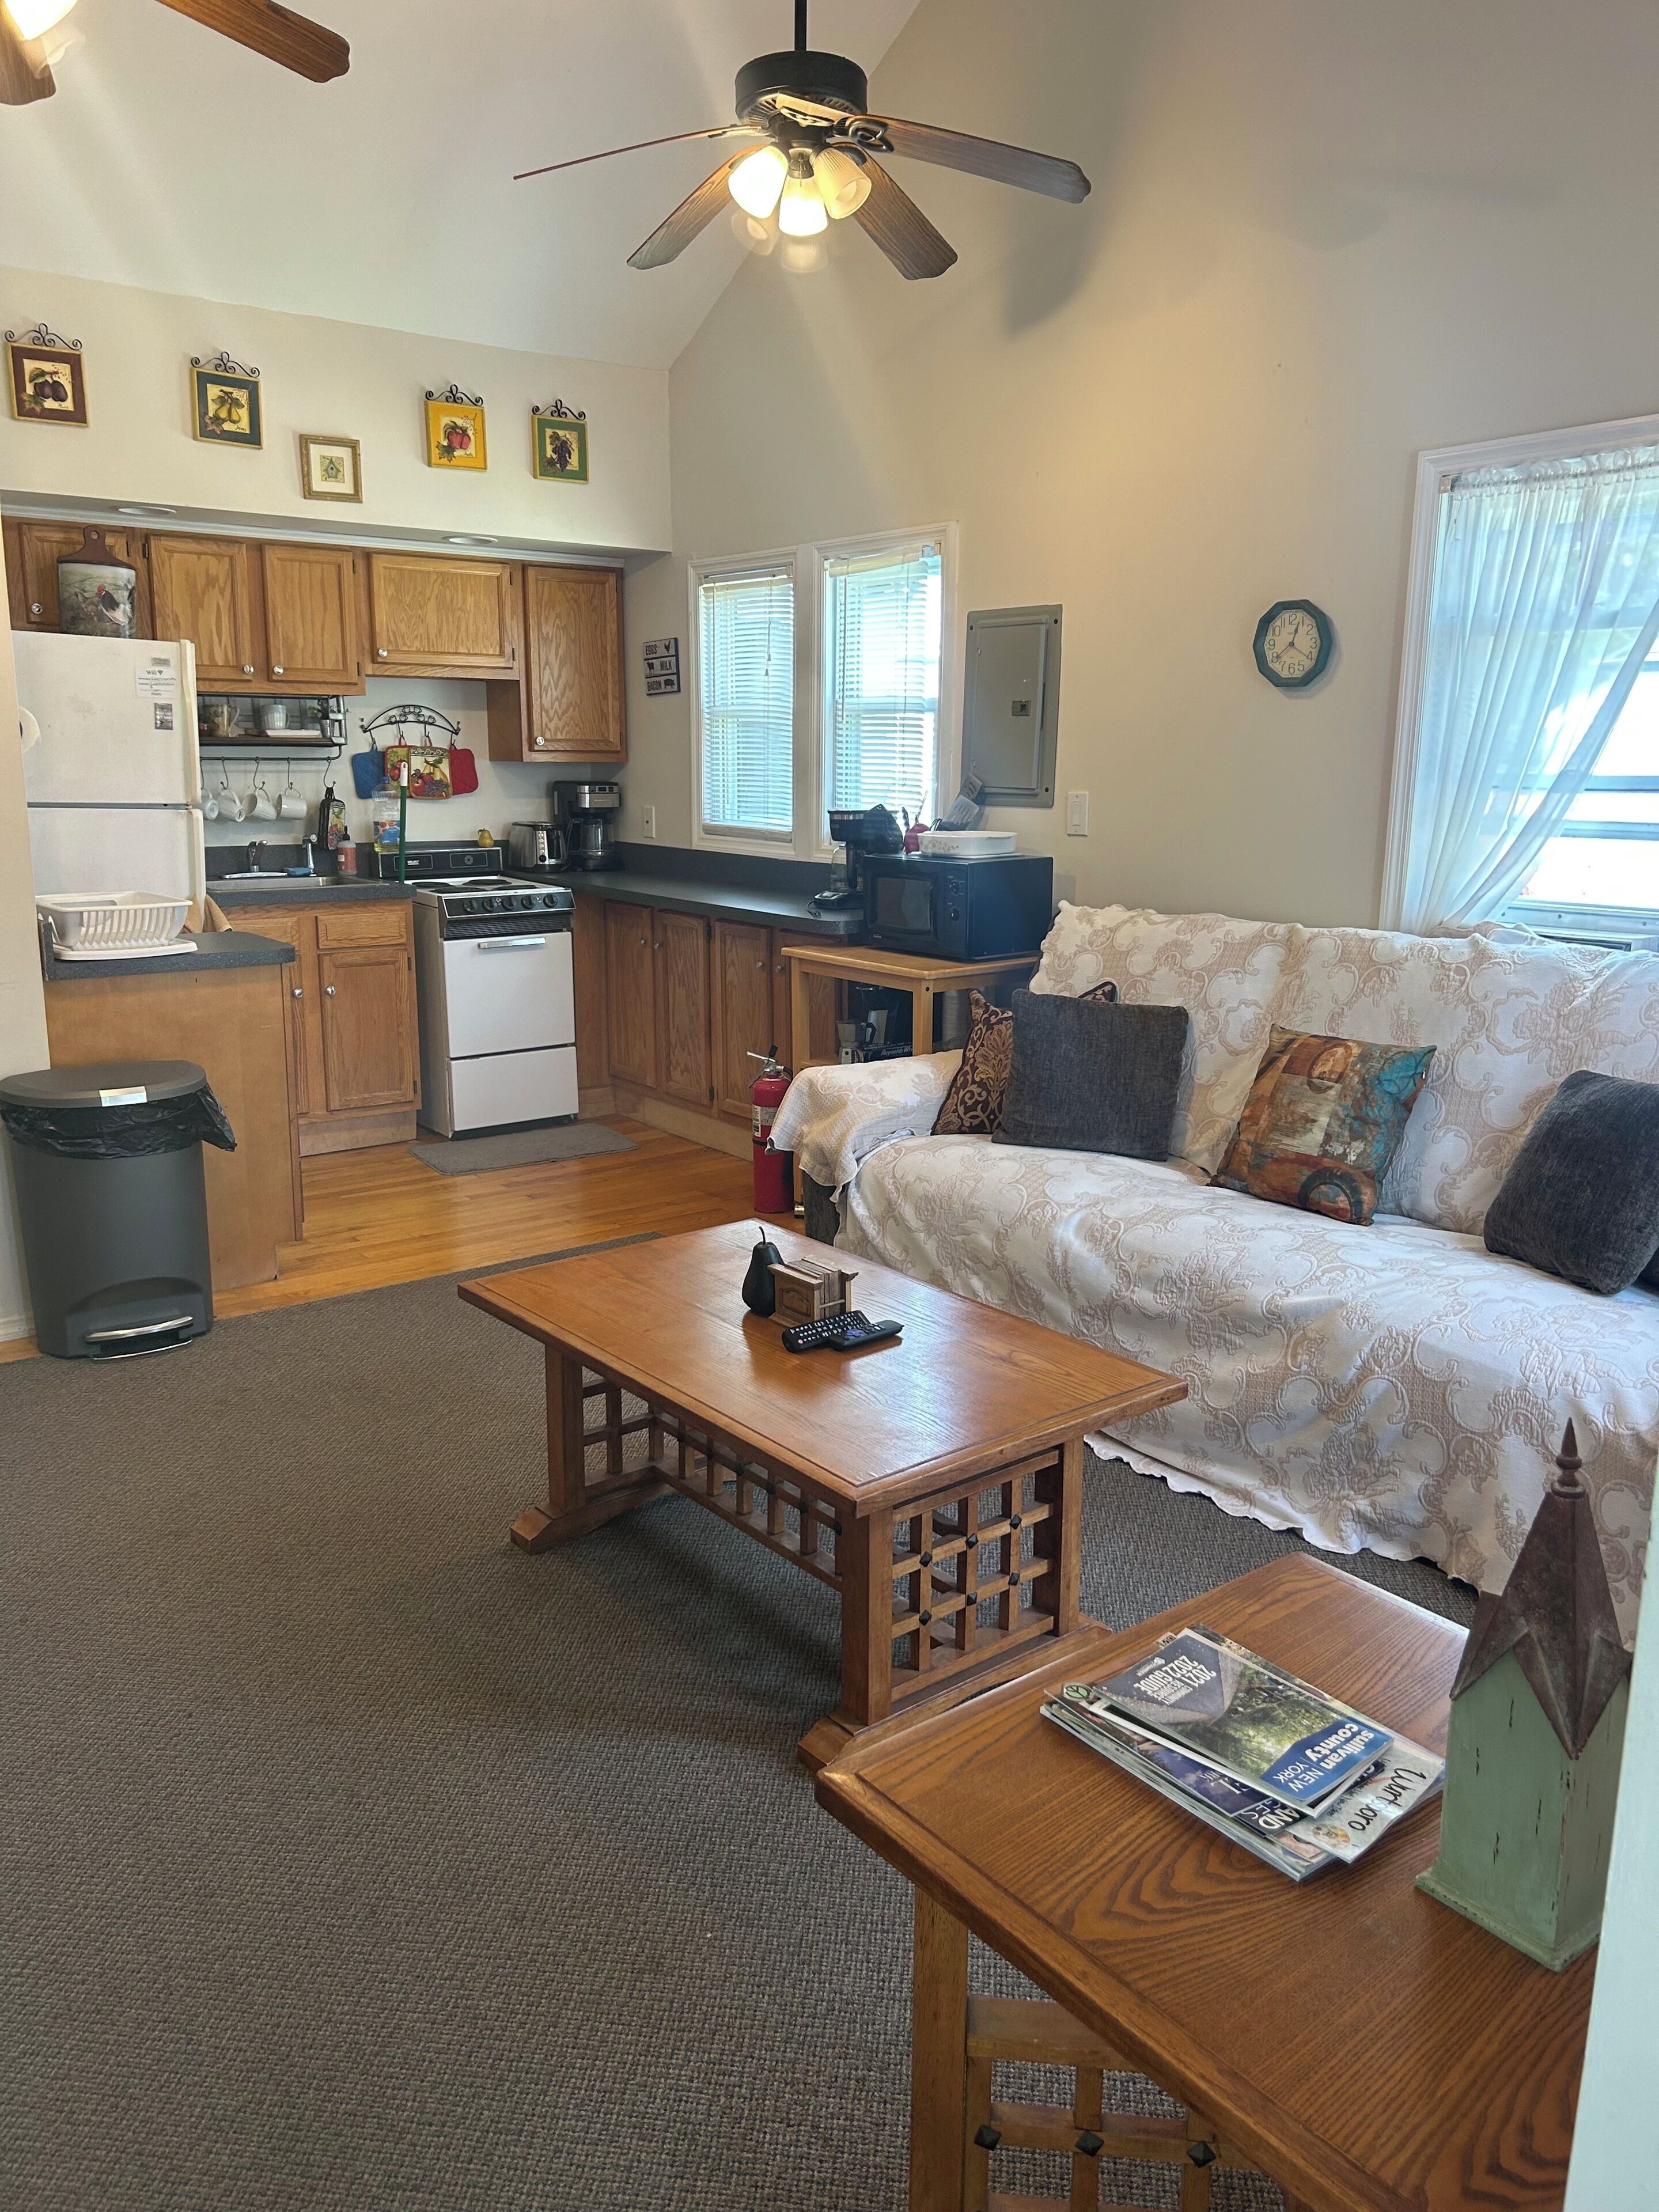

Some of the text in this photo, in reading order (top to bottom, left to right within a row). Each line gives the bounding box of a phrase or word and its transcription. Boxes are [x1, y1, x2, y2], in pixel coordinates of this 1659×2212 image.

[1289, 613, 1297, 625] 12
[1272, 625, 1281, 637] 10
[1306, 623, 1313, 636] 2
[1268, 638, 1275, 650] 9
[1309, 637, 1317, 649] 3
[645, 644, 657, 656] EGGS
[1306, 650, 1314, 662] 4
[1271, 652, 1279, 664] 8
[660, 660, 672, 671] MILK
[1279, 660, 1286, 672] 7
[1288, 662, 1296, 675] 6
[1297, 660, 1305, 672] 5
[647, 680, 662, 691] BACON
[1161, 1655, 1198, 1678] 2022
[1180, 1664, 1217, 1687] 2021
[1133, 1670, 1173, 1696] GUIDE
[1152, 1679, 1184, 1700] RESOURCE
[1305, 1723, 1358, 1762] county
[1319, 1730, 1374, 1769] sullivan
[1272, 1762, 1309, 1783] YORK
[1288, 1768, 1324, 1792] NEW
